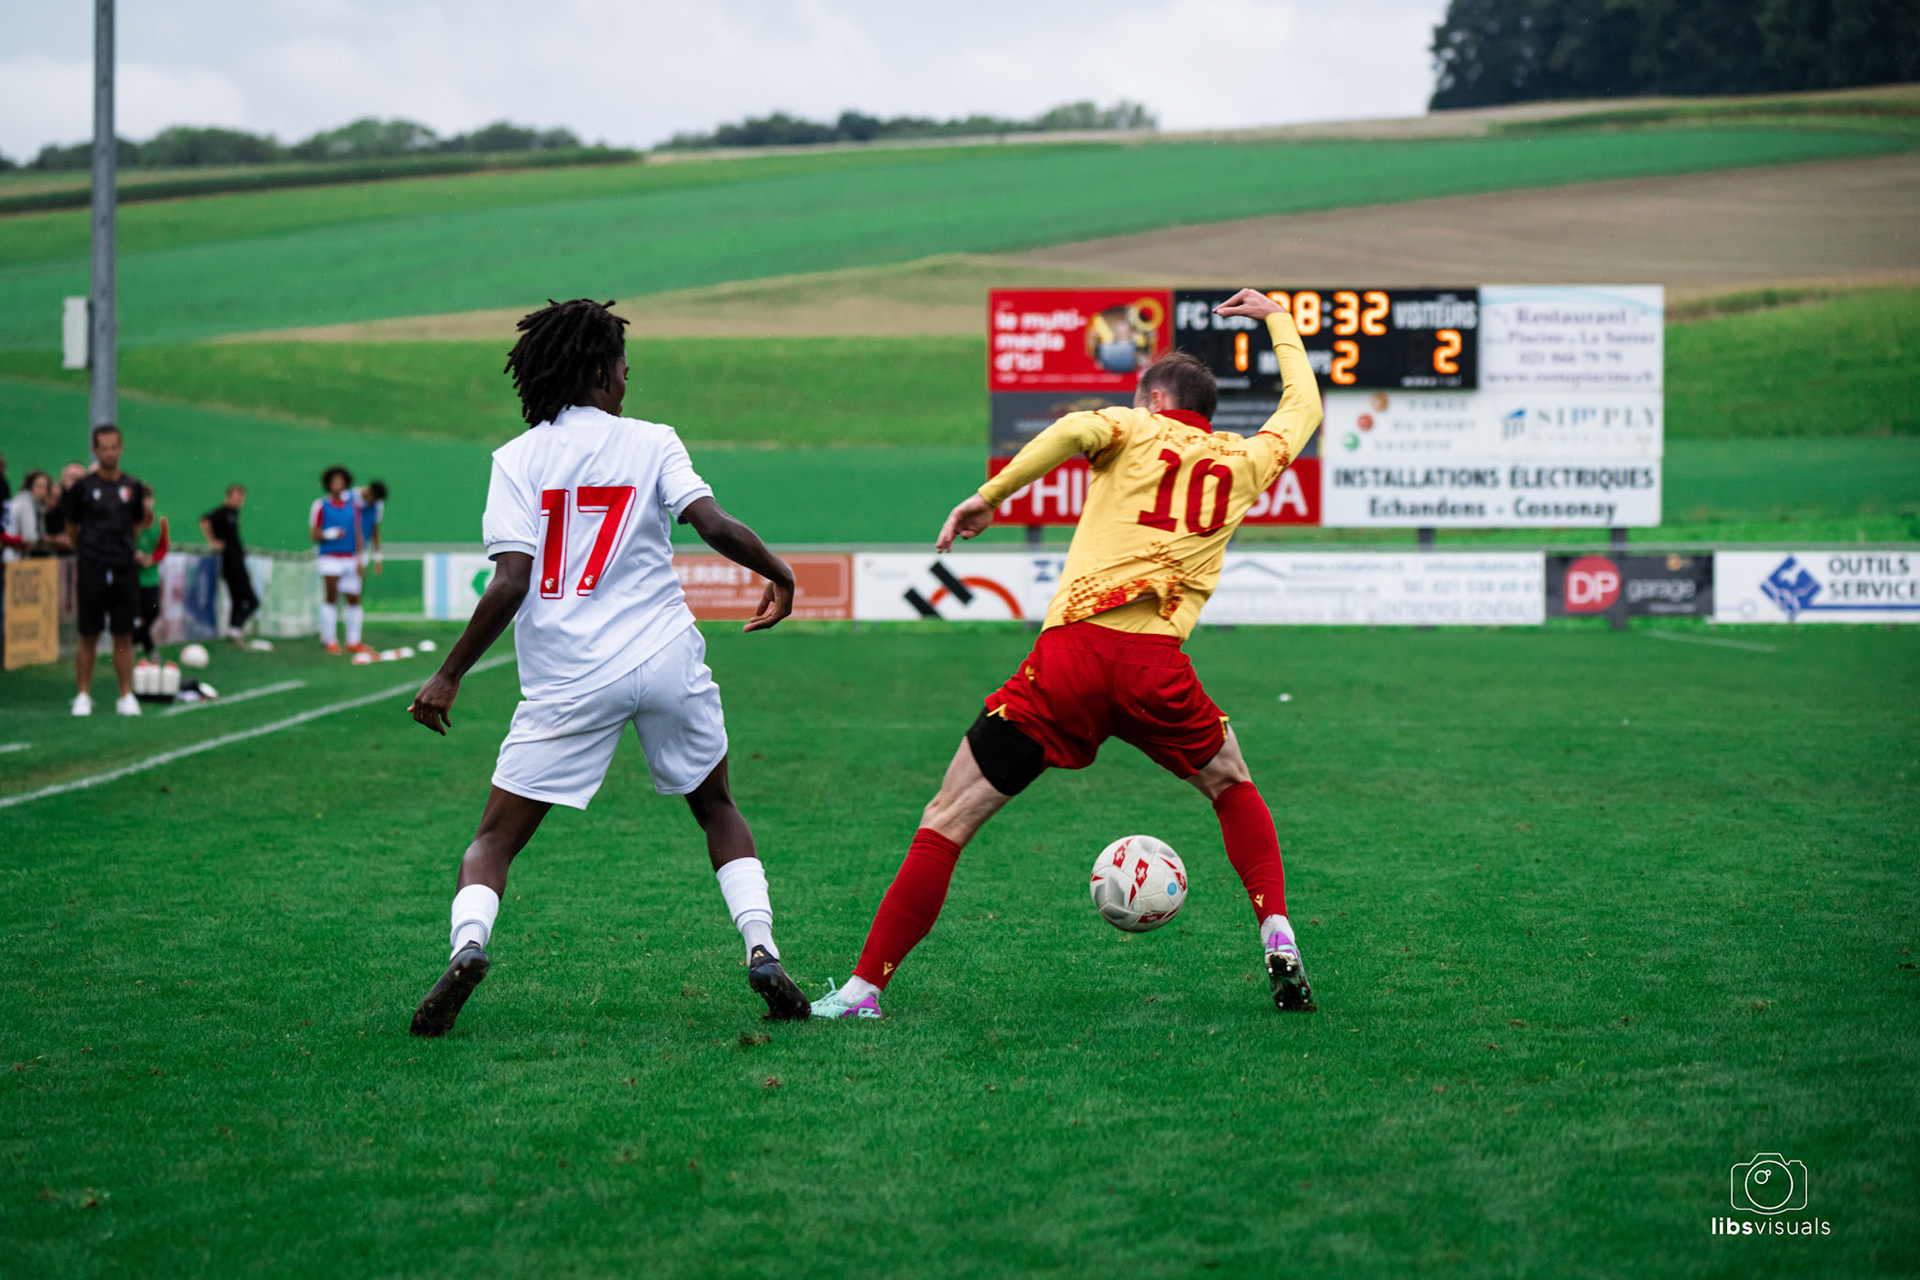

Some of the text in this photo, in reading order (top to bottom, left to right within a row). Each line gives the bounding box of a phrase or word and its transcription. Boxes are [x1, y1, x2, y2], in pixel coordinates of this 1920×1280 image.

[1176, 301, 1209, 330] FC
[1392, 301, 1477, 329] VISITEURS
[1234, 332, 1249, 372] 1
[1330, 340, 1360, 385] 2
[1433, 328, 1463, 374] 2
[1138, 448, 1233, 537] 10
[1333, 466, 1500, 490] INSTALLATIONS
[541, 485, 637, 599] 17
[1828, 556, 1911, 576] OUTILS
[1568, 571, 1619, 604] DP
[1625, 579, 1697, 604] garage
[1829, 580, 1919, 600] SERVICE
